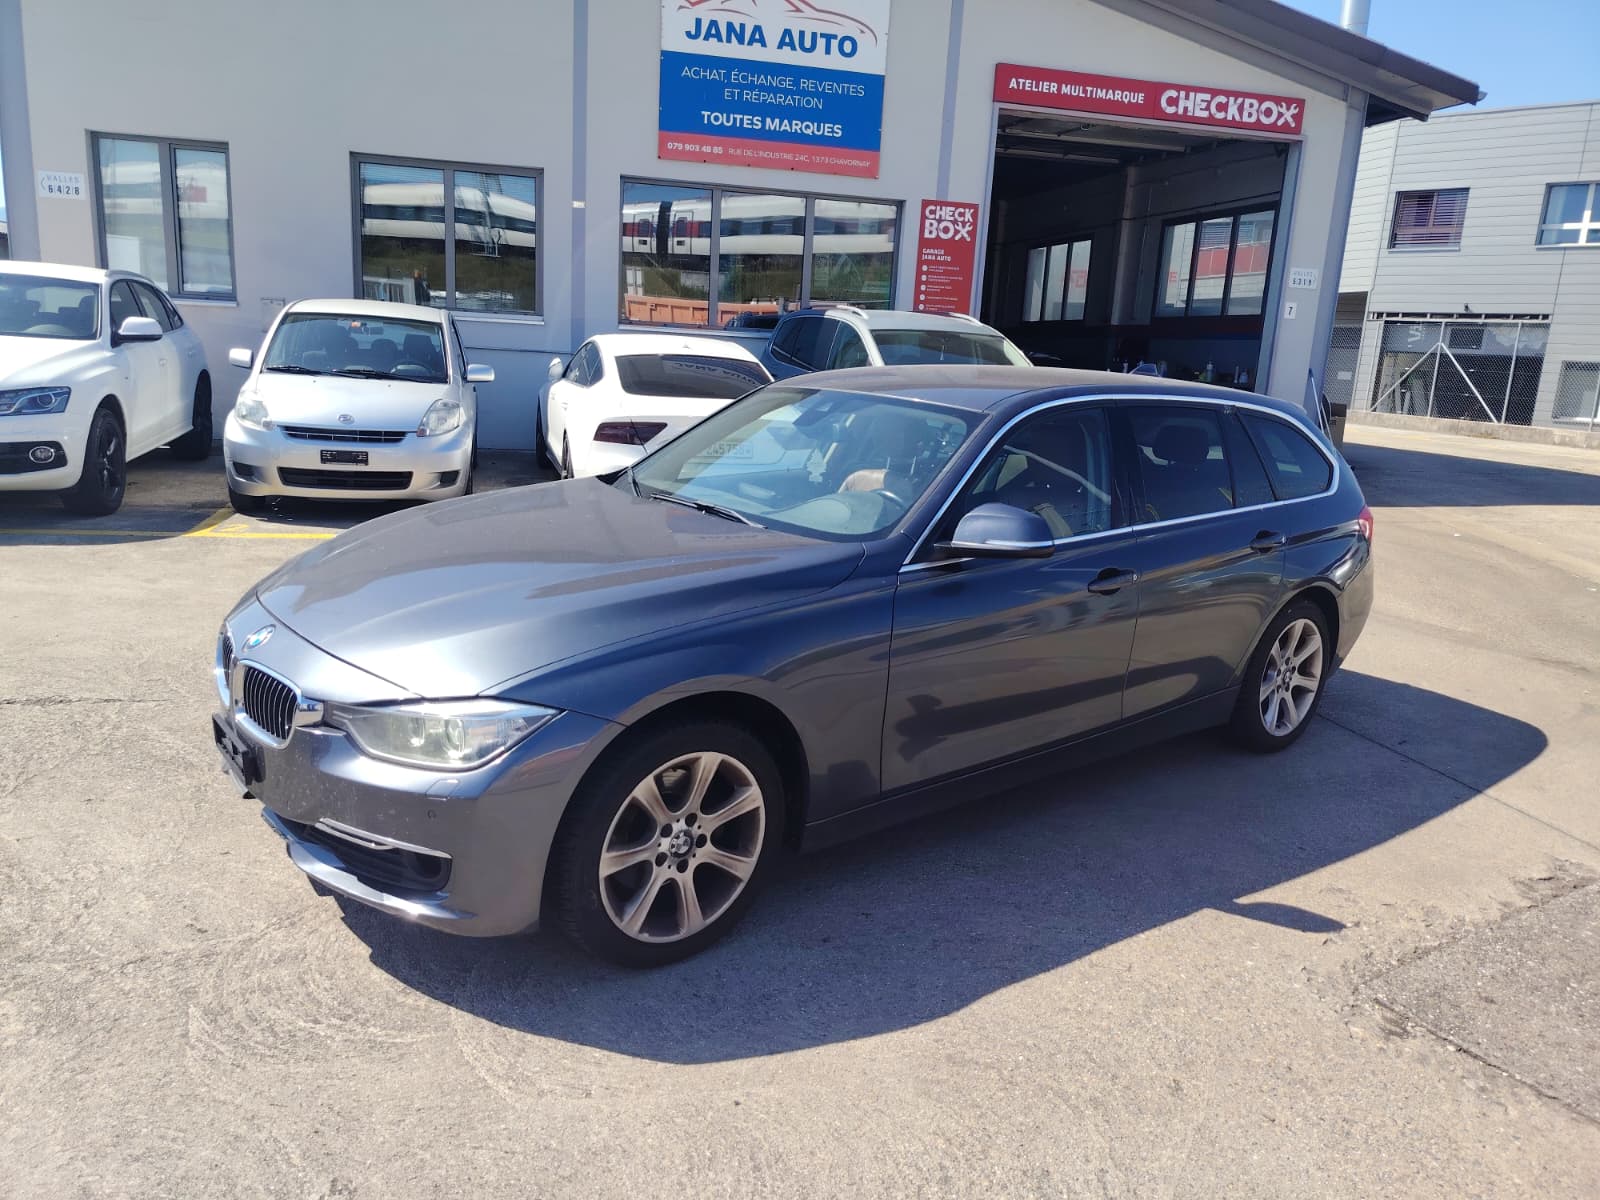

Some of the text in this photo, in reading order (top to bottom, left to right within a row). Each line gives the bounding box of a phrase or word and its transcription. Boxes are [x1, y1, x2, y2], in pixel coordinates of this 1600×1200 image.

[685, 18, 857, 58] JANA AUTO
[681, 66, 865, 96] ACHAT, ÉCHANGE, REVENTES
[724, 88, 823, 110] ET RÉPARATION
[1009, 77, 1299, 128] ATELIER MULTIMARQUE CHECKBOX
[702, 111, 843, 138] TOUTES MARQUES
[667, 142, 683, 150] 079
[728, 147, 742, 155] RUE
[744, 149, 753, 157] DE
[925, 205, 975, 222] CHECK
[924, 219, 973, 242] BOX
